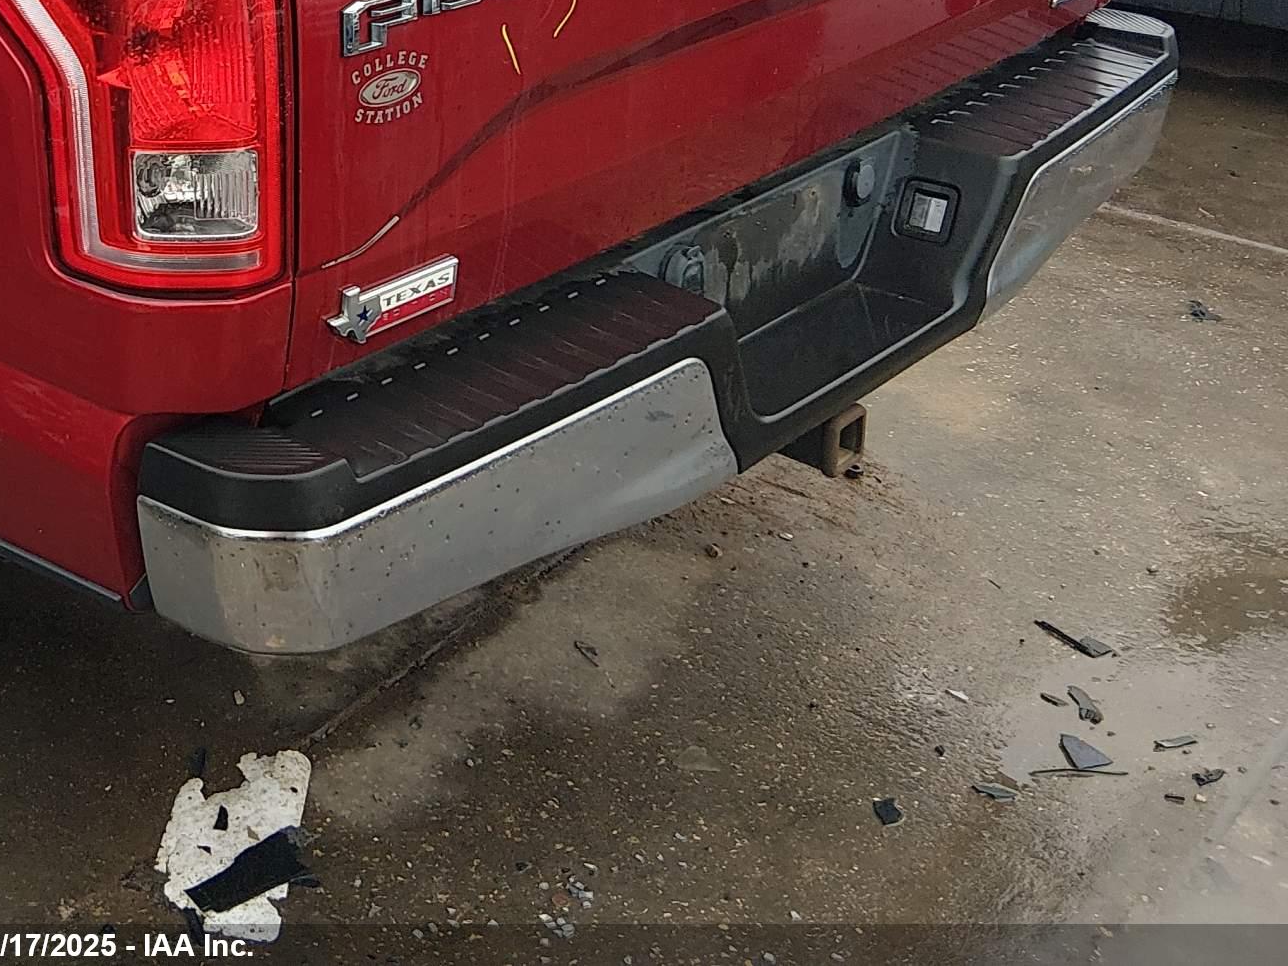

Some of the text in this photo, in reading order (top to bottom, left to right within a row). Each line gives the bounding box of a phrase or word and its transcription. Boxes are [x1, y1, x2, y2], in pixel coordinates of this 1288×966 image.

[351, 50, 429, 85] COLLEGE
[371, 77, 409, 100] Ford
[354, 91, 424, 125] STATION
[382, 272, 450, 308] TEXAS
